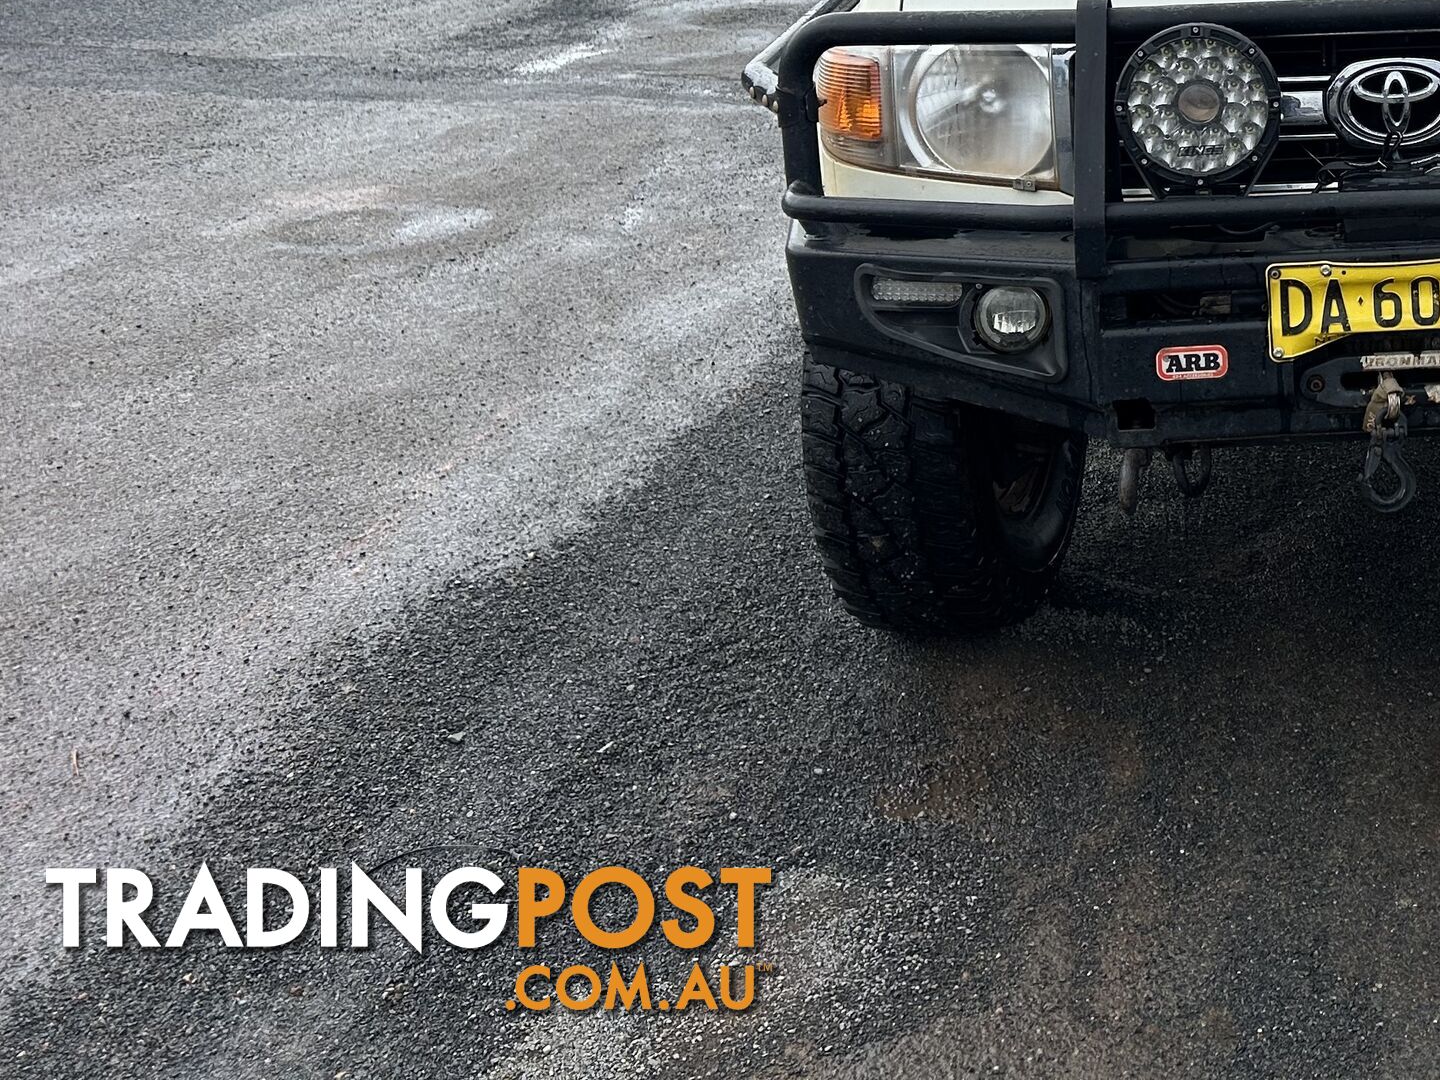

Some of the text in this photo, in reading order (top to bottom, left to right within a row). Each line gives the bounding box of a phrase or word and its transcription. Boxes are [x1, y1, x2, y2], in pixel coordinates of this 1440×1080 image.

[1280, 278, 1350, 337] DA
[1372, 276, 1440, 328] 60
[1165, 352, 1220, 373] ARB
